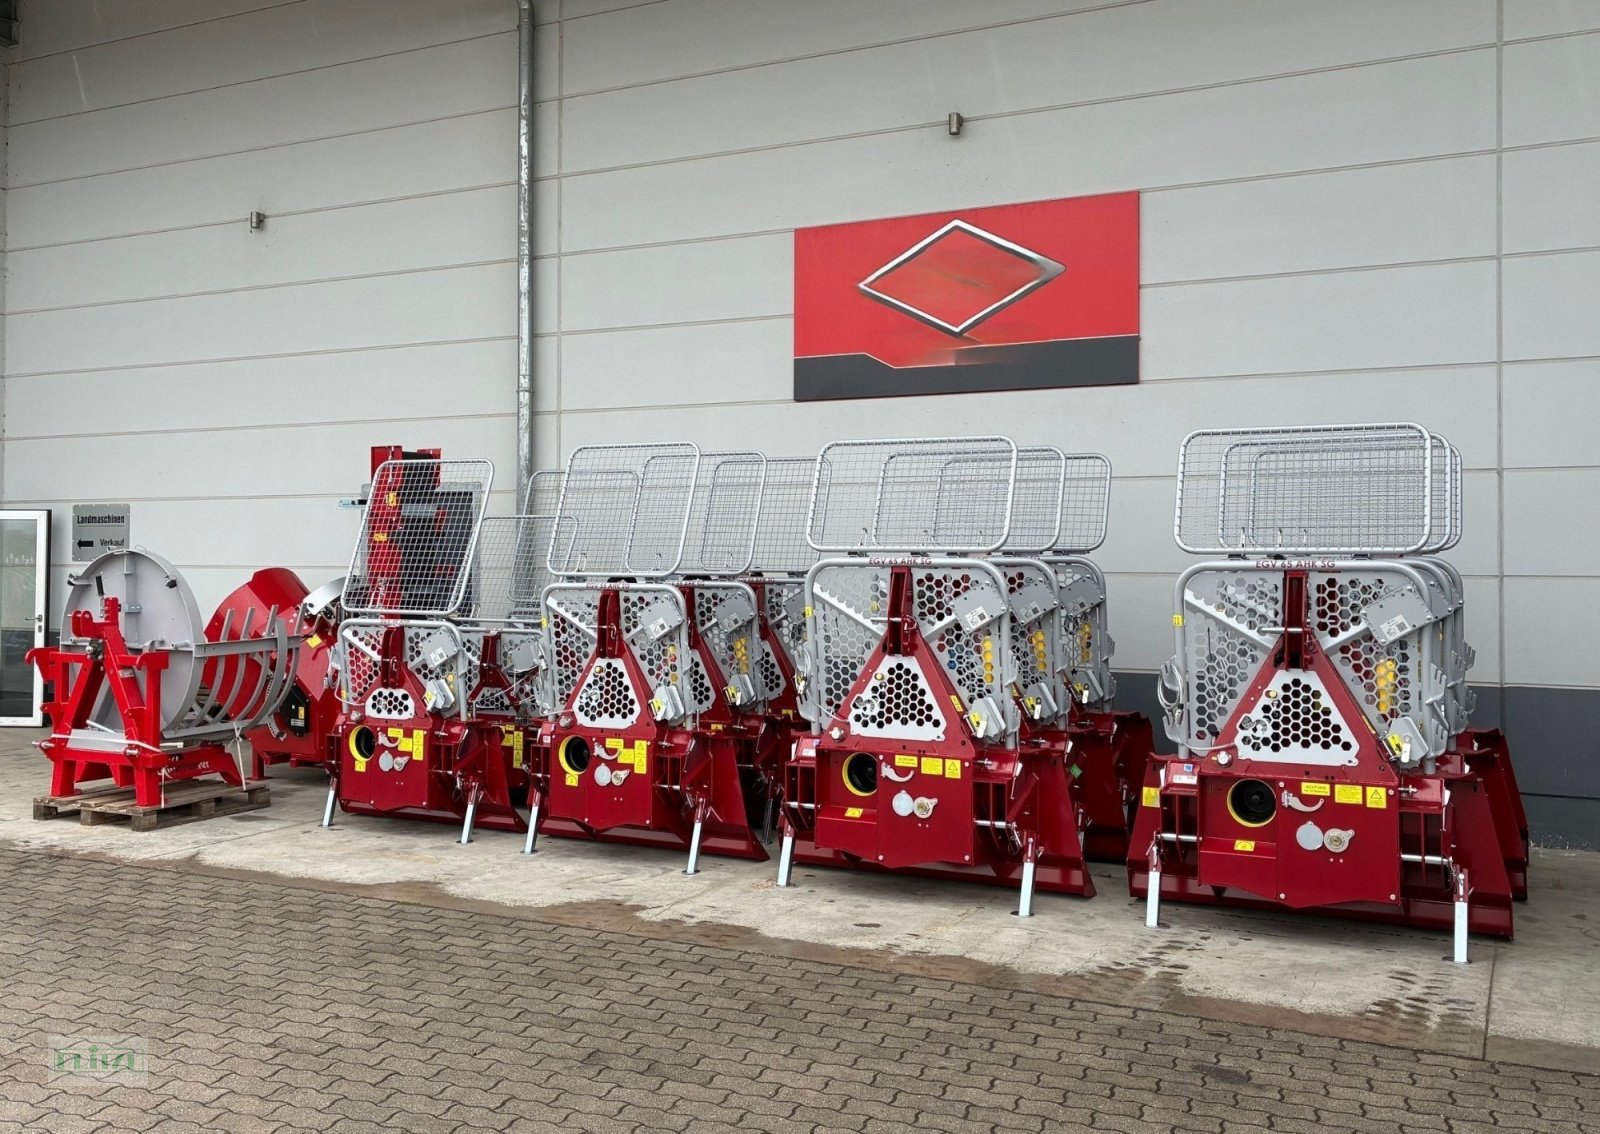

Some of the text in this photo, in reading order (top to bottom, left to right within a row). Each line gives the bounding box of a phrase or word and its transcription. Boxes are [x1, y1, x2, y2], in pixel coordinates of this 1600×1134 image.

[77, 514, 125, 524] Landmaschinen
[100, 538, 125, 547] Verkauf
[1255, 560, 1336, 569] EGV 65 AHK SG
